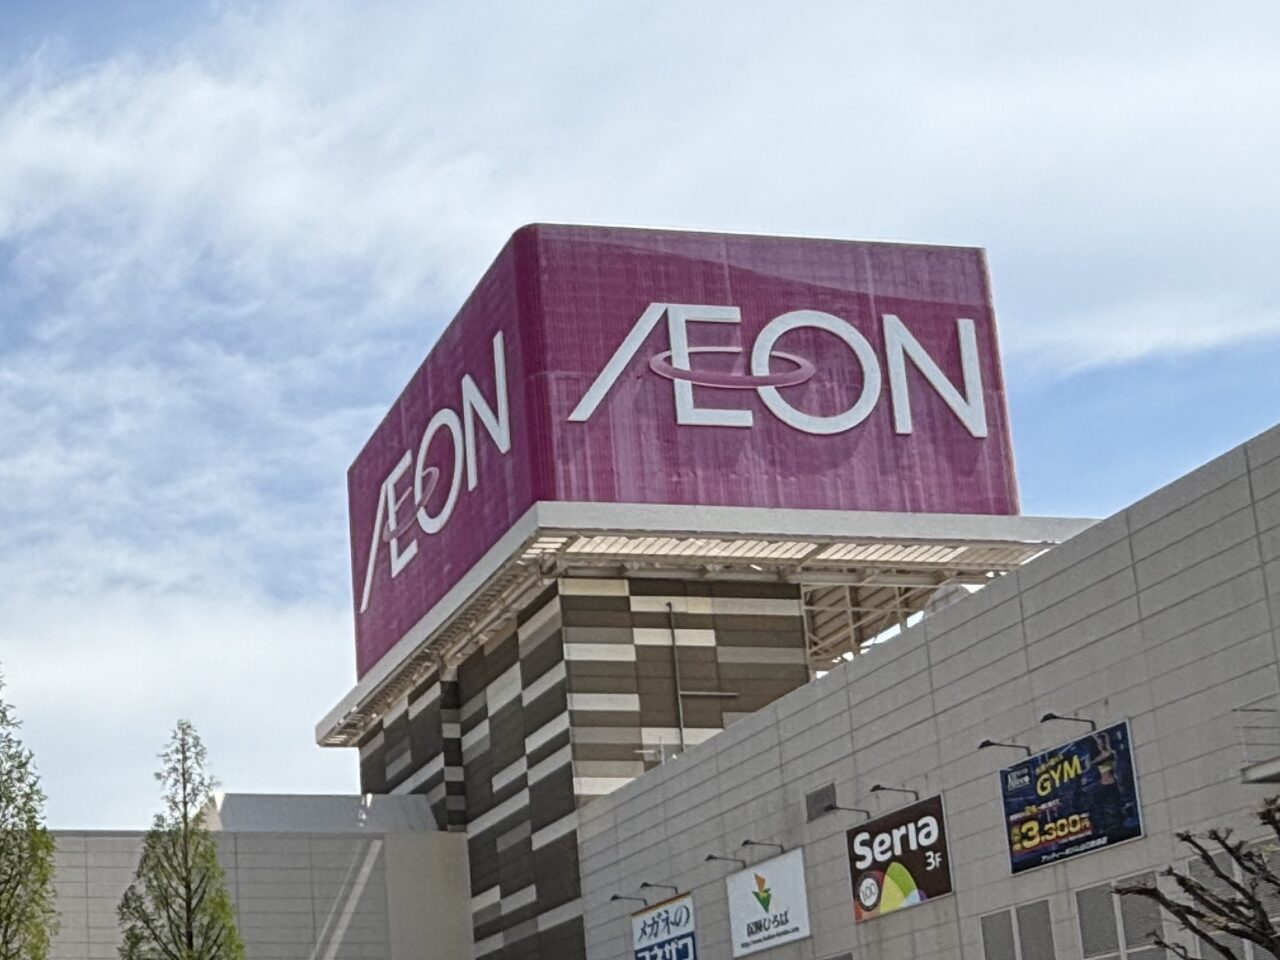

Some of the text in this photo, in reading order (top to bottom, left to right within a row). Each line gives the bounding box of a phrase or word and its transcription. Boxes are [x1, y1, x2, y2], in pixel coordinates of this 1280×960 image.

[1036, 754, 1082, 796] GYM
[853, 815, 939, 870] Seria
[925, 850, 942, 872] 3F
[638, 904, 690, 942] メガネの
